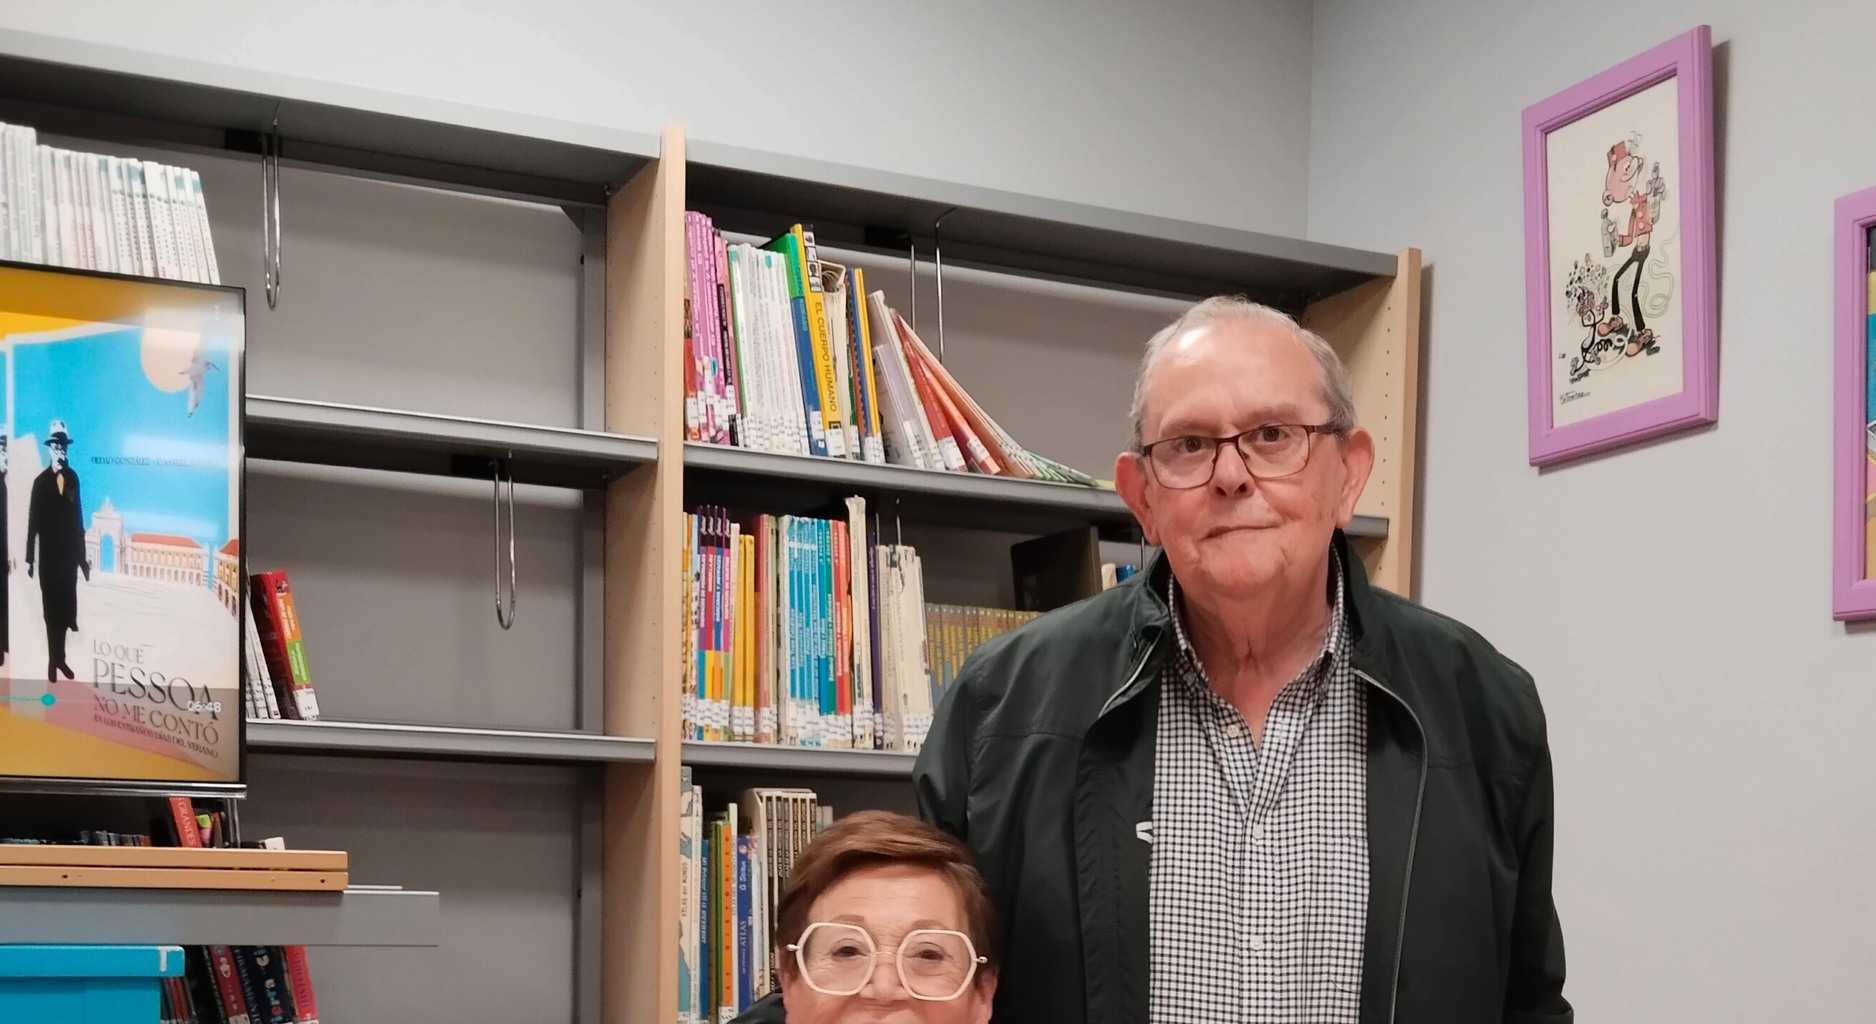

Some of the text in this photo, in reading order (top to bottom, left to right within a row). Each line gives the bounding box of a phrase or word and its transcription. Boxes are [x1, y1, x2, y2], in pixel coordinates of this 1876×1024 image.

[814, 301, 838, 412] EL CUERPO HUMANO
[93, 639, 144, 664] LO QUE
[94, 658, 219, 720] PESSOA
[187, 700, 222, 713] 06:48
[94, 694, 219, 745] NO ME CONTÓ
[118, 719, 155, 740] EXTRAÑOS
[188, 741, 219, 759] VERANO
[740, 920, 748, 946] ATLAS
